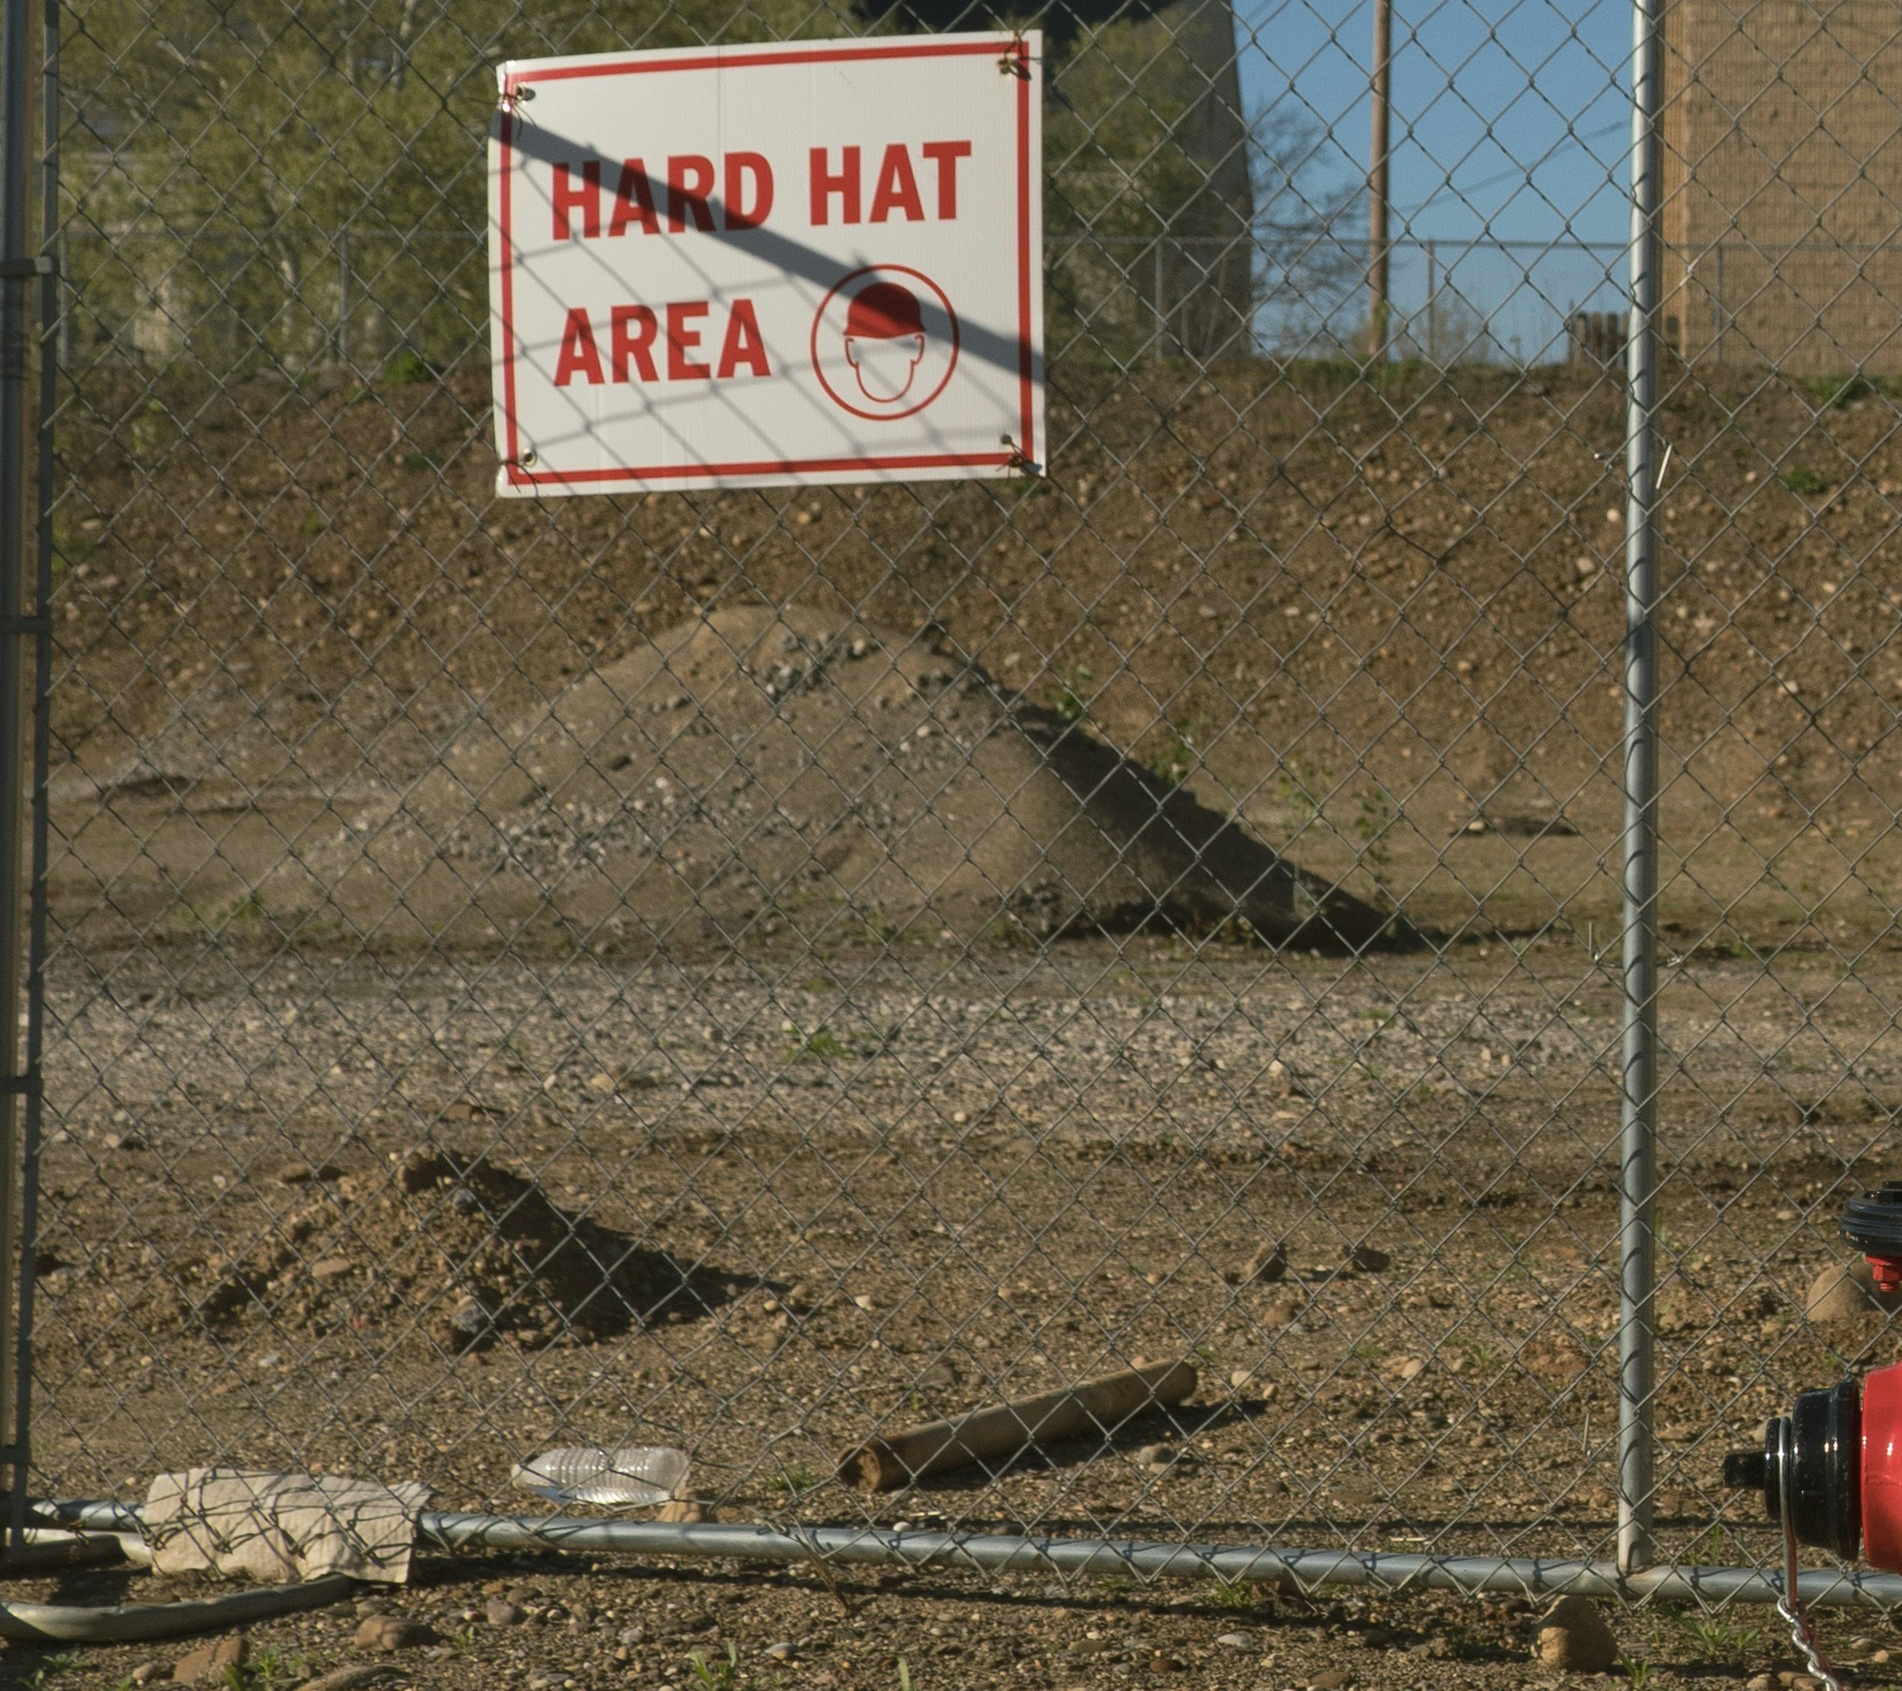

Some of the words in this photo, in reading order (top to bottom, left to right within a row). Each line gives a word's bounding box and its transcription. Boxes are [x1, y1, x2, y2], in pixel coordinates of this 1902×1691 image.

[552, 151, 774, 241] HARD
[809, 140, 972, 226] HAT
[554, 298, 770, 387] AREA
